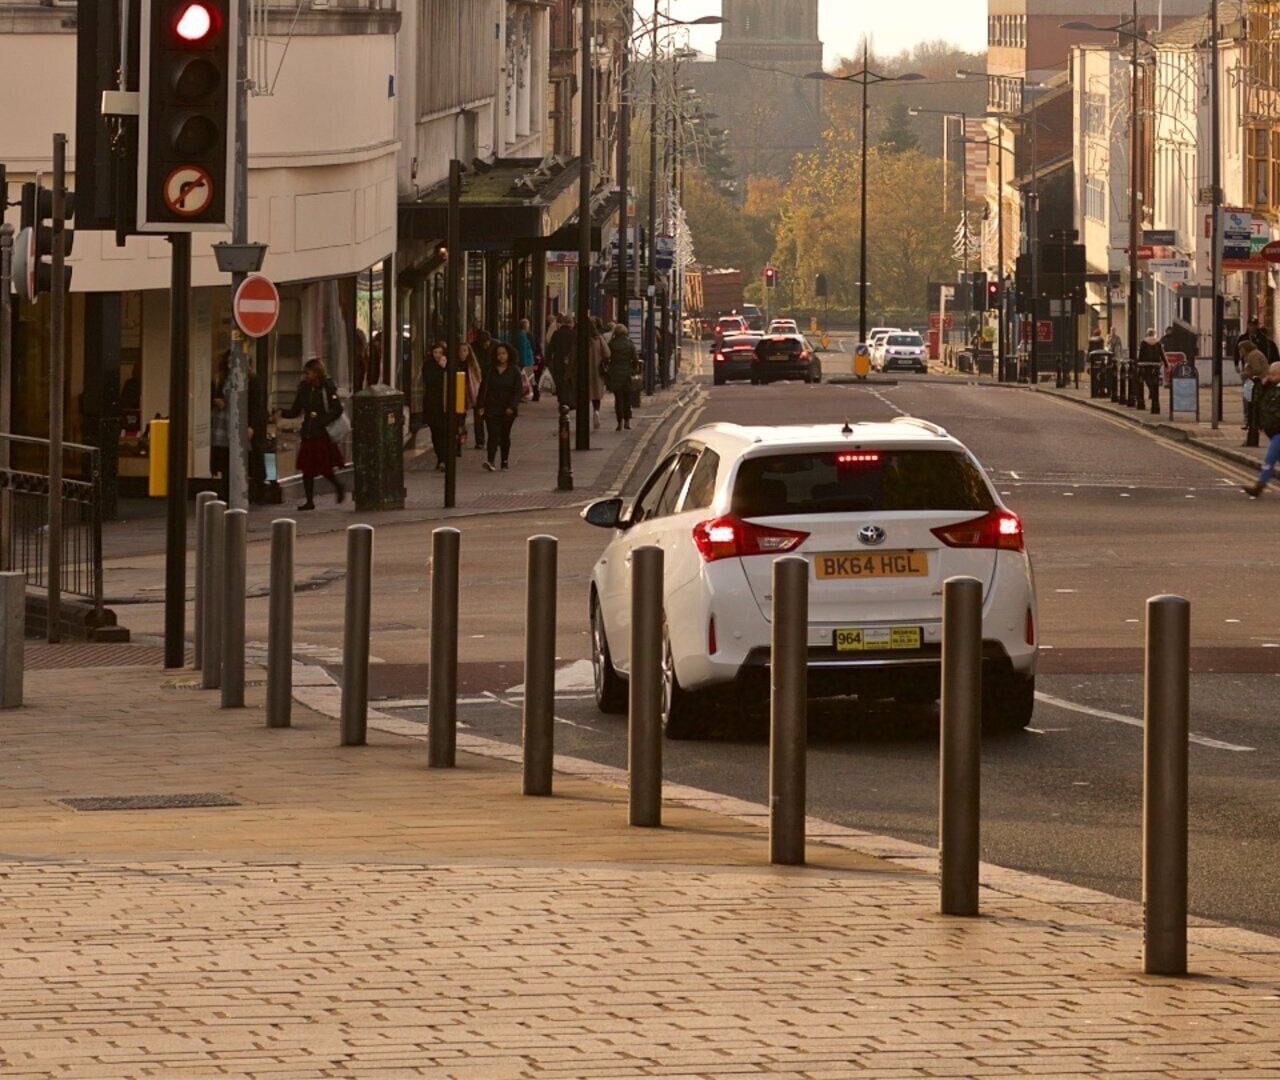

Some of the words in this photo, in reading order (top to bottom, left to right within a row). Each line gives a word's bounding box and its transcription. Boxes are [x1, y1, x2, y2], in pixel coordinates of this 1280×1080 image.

[823, 557, 874, 575] BK64
[881, 556, 920, 574] HGL
[838, 632, 861, 645] 964
